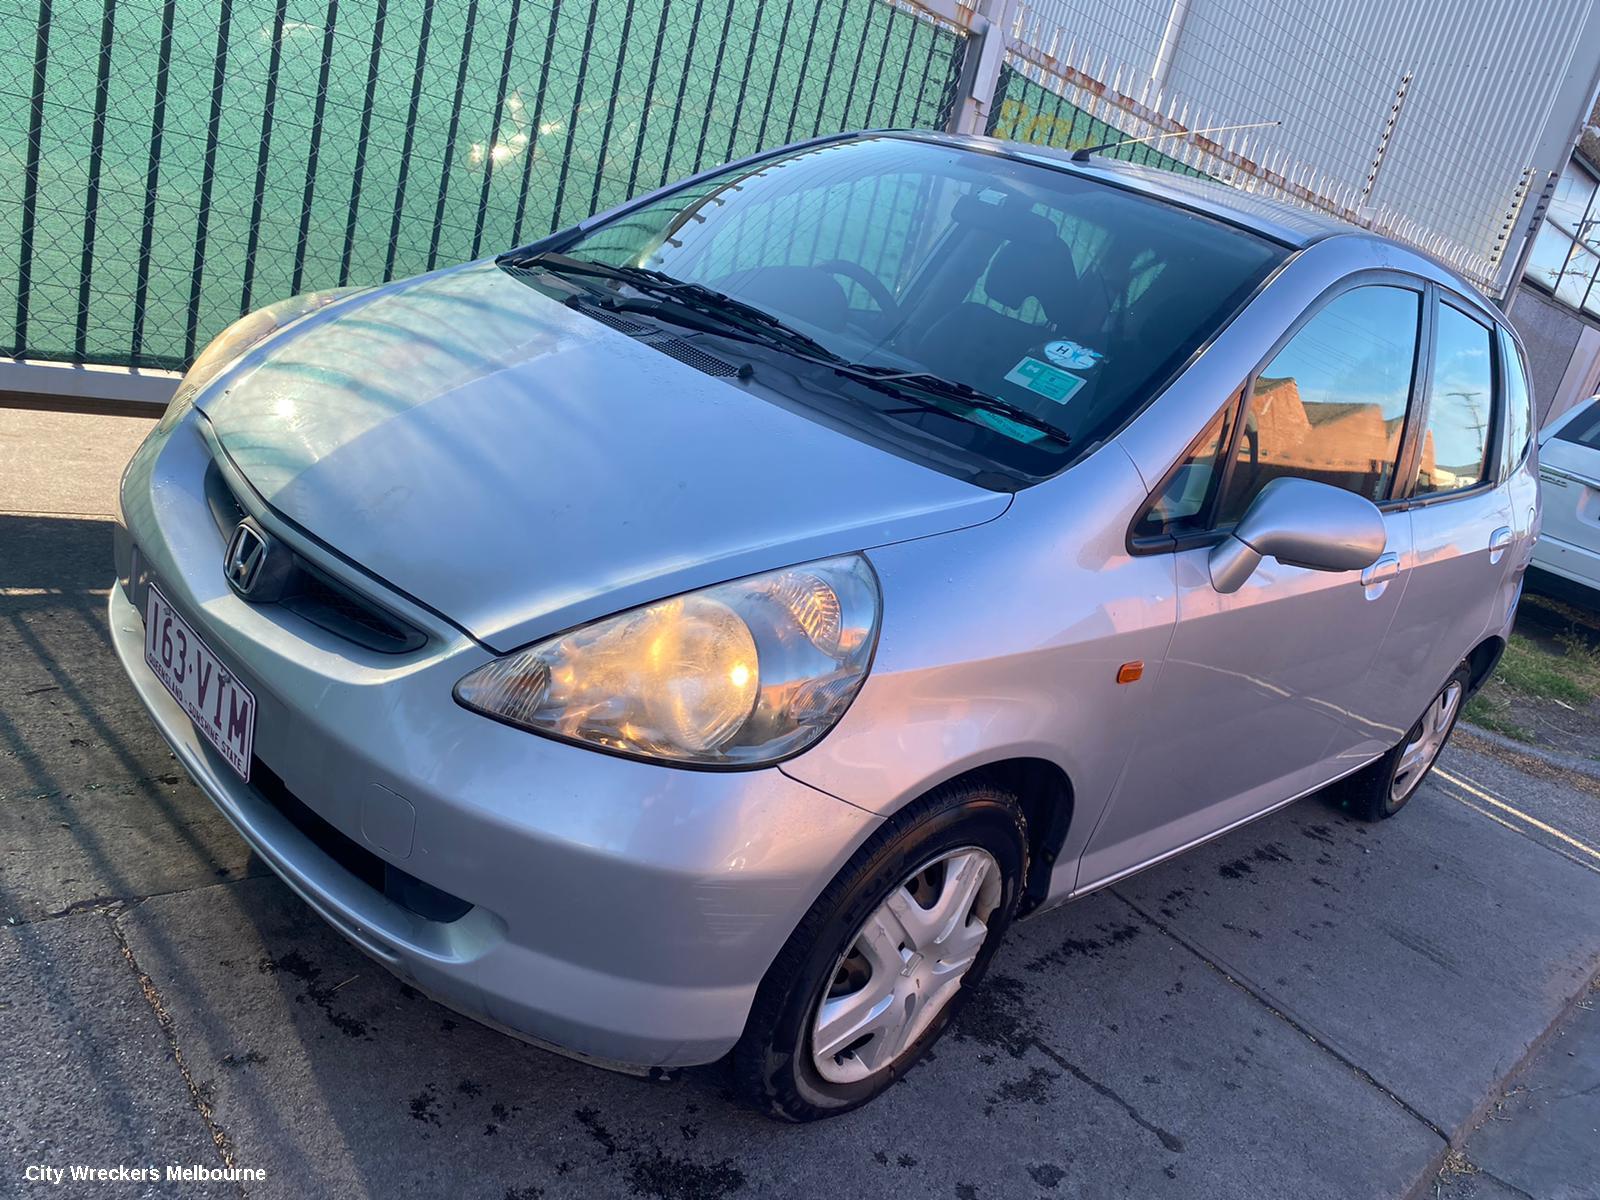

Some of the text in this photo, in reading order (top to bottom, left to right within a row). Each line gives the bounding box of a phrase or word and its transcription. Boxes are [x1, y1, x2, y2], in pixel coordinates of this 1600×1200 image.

[148, 652, 183, 702] QUEENSLAND
[188, 702, 219, 746] SUNSHINE
[221, 741, 243, 772] STATE
